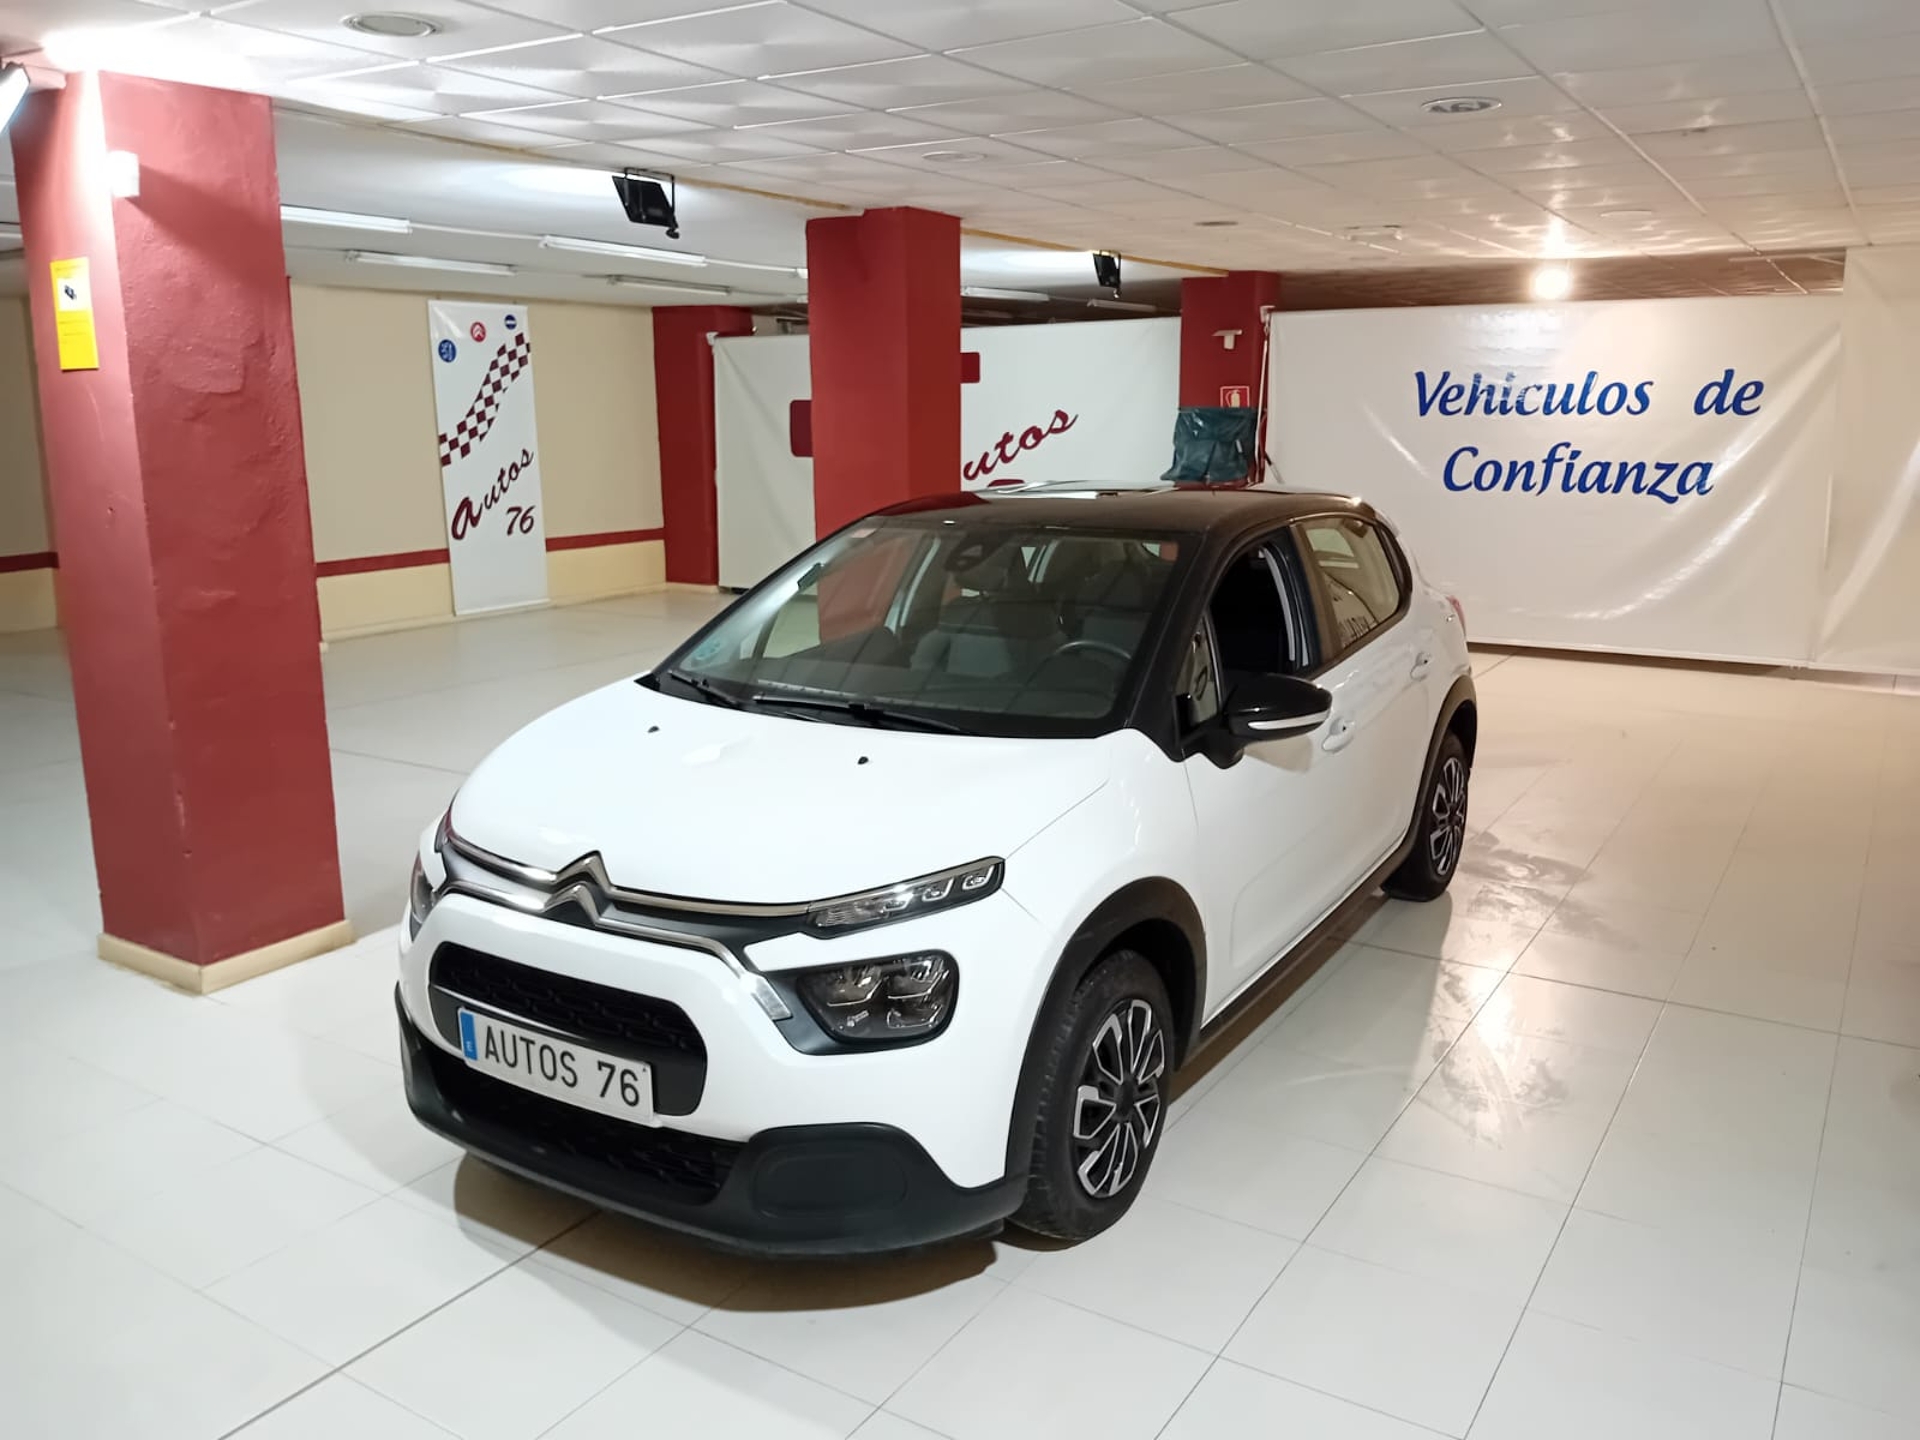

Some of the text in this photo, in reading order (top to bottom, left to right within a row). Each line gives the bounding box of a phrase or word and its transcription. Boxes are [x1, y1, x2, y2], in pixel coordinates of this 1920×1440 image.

[1692, 368, 1765, 417] de
[962, 408, 1079, 481] utos
[1442, 441, 1714, 505] Confianza
[505, 504, 536, 536] 76
[484, 1025, 578, 1089] AUTOS
[597, 1060, 640, 1108] 76
